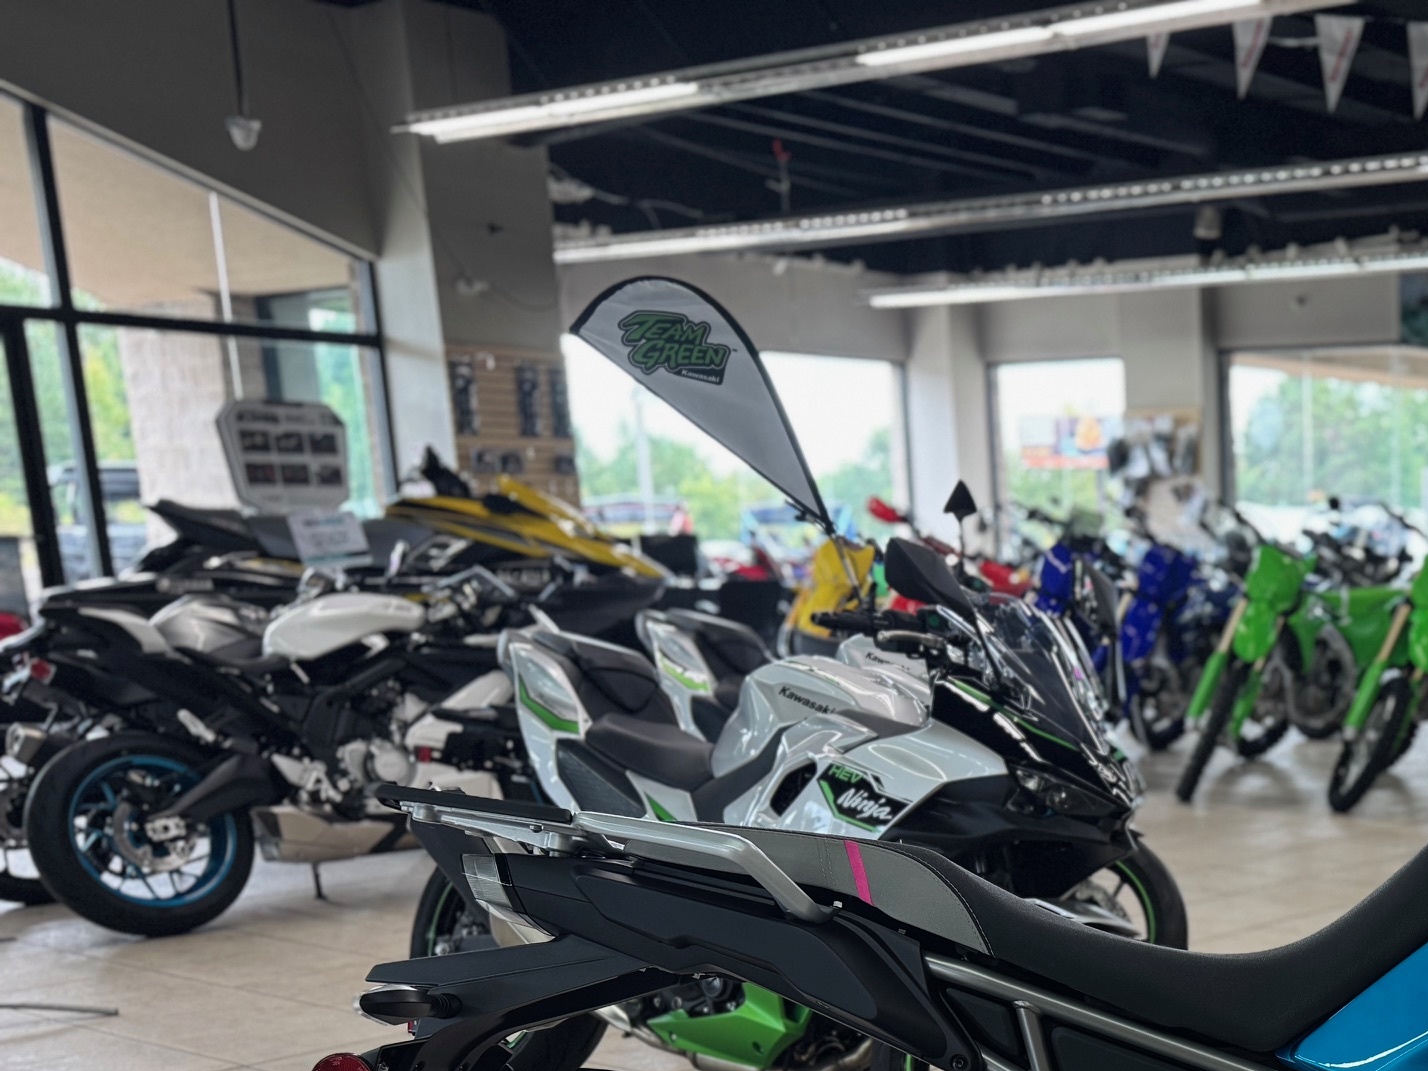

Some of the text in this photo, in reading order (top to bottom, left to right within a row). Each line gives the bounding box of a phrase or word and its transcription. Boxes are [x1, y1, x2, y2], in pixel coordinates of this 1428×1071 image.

[619, 312, 707, 345] TEAM
[632, 340, 727, 369] GREEN
[681, 369, 720, 382] Kawasaki
[778, 685, 836, 714] Kawasaki
[828, 764, 864, 784] HEV
[836, 788, 893, 820] Ninja
